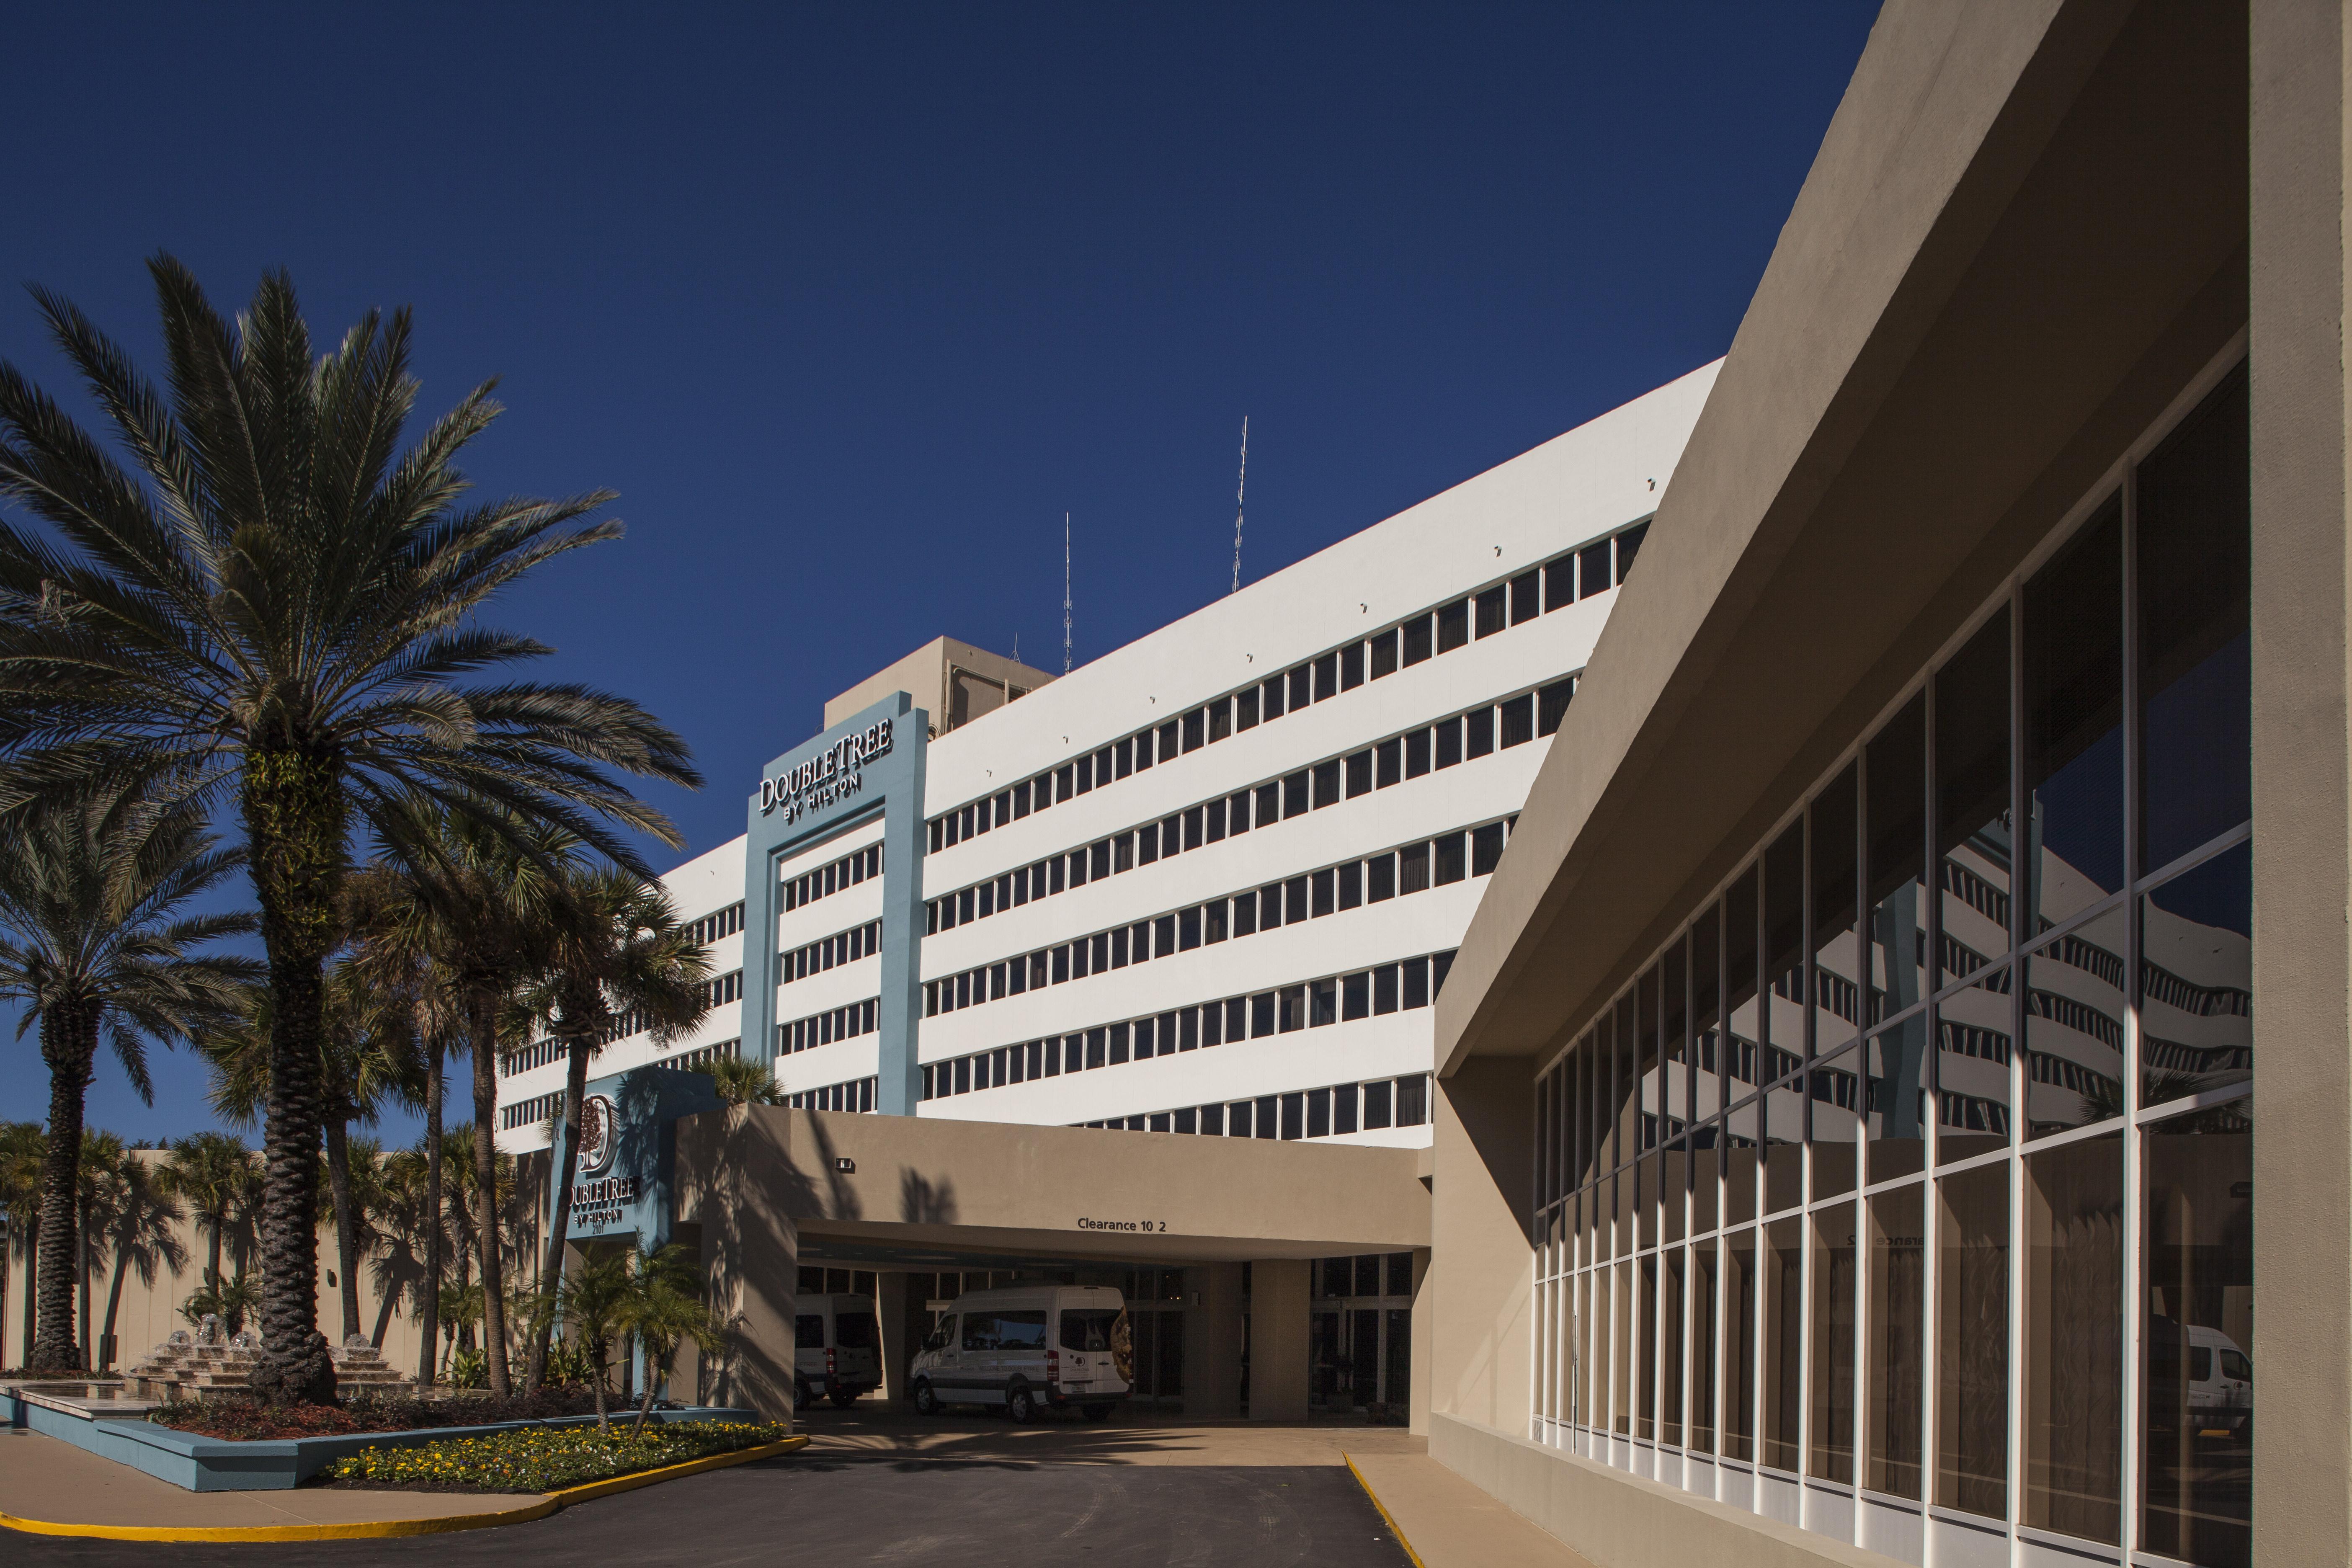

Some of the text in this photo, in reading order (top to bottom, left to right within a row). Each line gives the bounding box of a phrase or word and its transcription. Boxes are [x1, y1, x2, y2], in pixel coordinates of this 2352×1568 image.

[784, 773, 859, 820] BY HILTON
[574, 1209, 619, 1224] BY HILTON
[593, 1225, 604, 1235] 2101
[1078, 1217, 1166, 1232] Clearance 10 2
